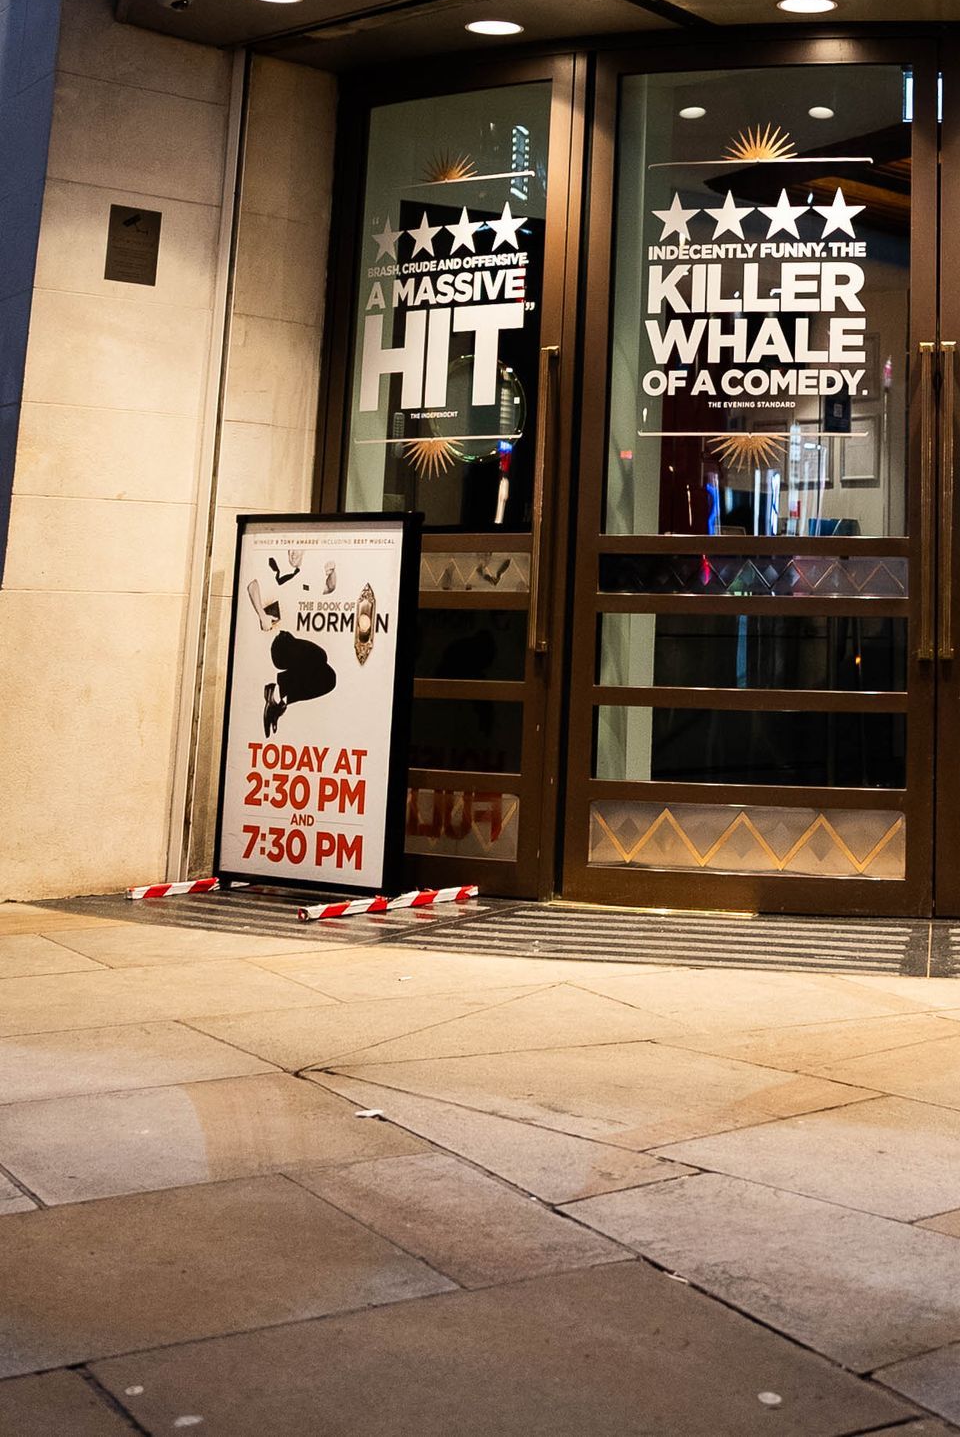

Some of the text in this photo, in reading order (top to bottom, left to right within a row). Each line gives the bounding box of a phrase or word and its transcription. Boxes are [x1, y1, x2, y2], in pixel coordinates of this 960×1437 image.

[647, 241, 867, 261] INDECENTLY FUNNY. THE
[367, 264, 401, 278] BRASH,
[402, 259, 437, 274] CRUDE
[437, 257, 462, 271] AND
[365, 267, 526, 310] A MASSIVE
[647, 261, 867, 314] KILLER
[644, 317, 867, 364] WHALE
[642, 369, 869, 397] OF A COMEDY.
[707, 401, 796, 409] THE EVENING STANDARD
[298, 601, 356, 612] THE BOOK OF
[248, 743, 368, 776] TODAY AT
[243, 771, 366, 815] 2:30 PM
[290, 813, 314, 827] AND
[242, 824, 363, 870] 7:30 PM
